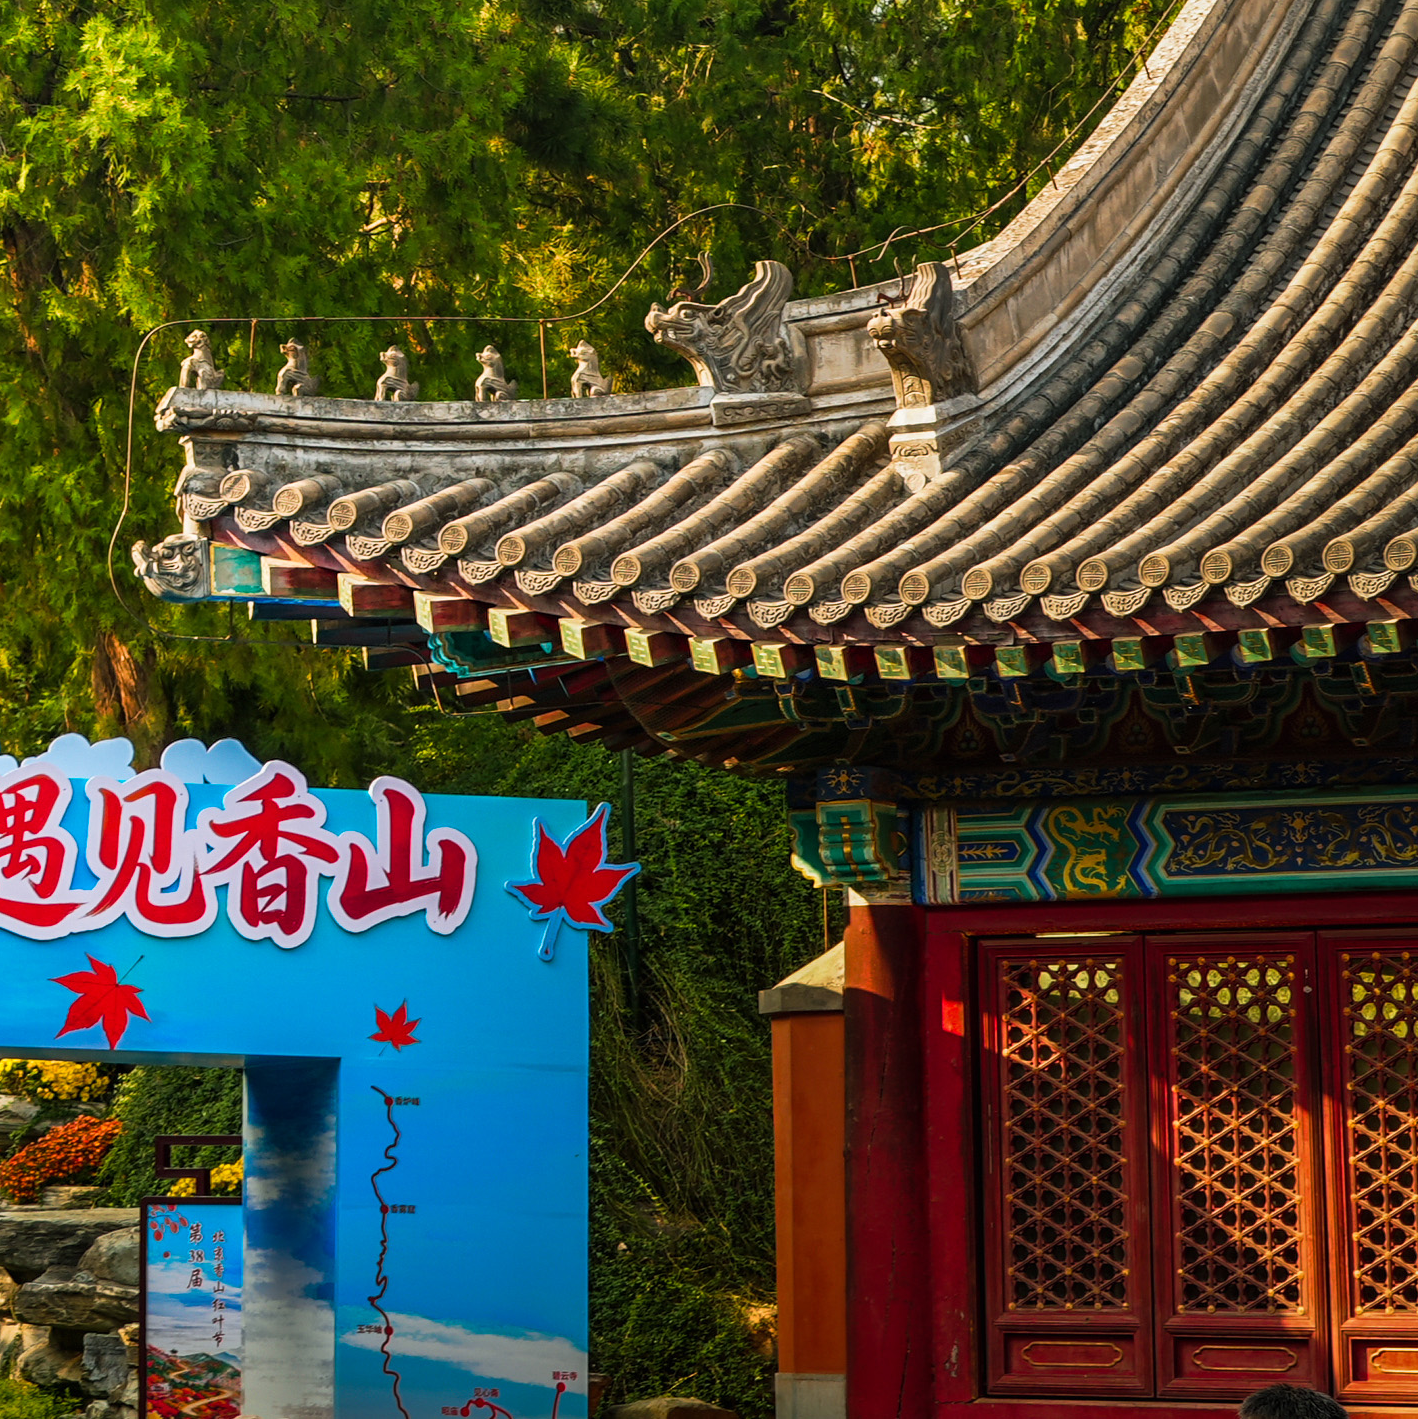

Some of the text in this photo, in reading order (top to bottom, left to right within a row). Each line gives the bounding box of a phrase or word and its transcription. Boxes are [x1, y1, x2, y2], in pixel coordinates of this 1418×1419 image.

[187, 1222, 204, 1289] 第38届
[212, 1230, 225, 1348] 北京香山红叶节
